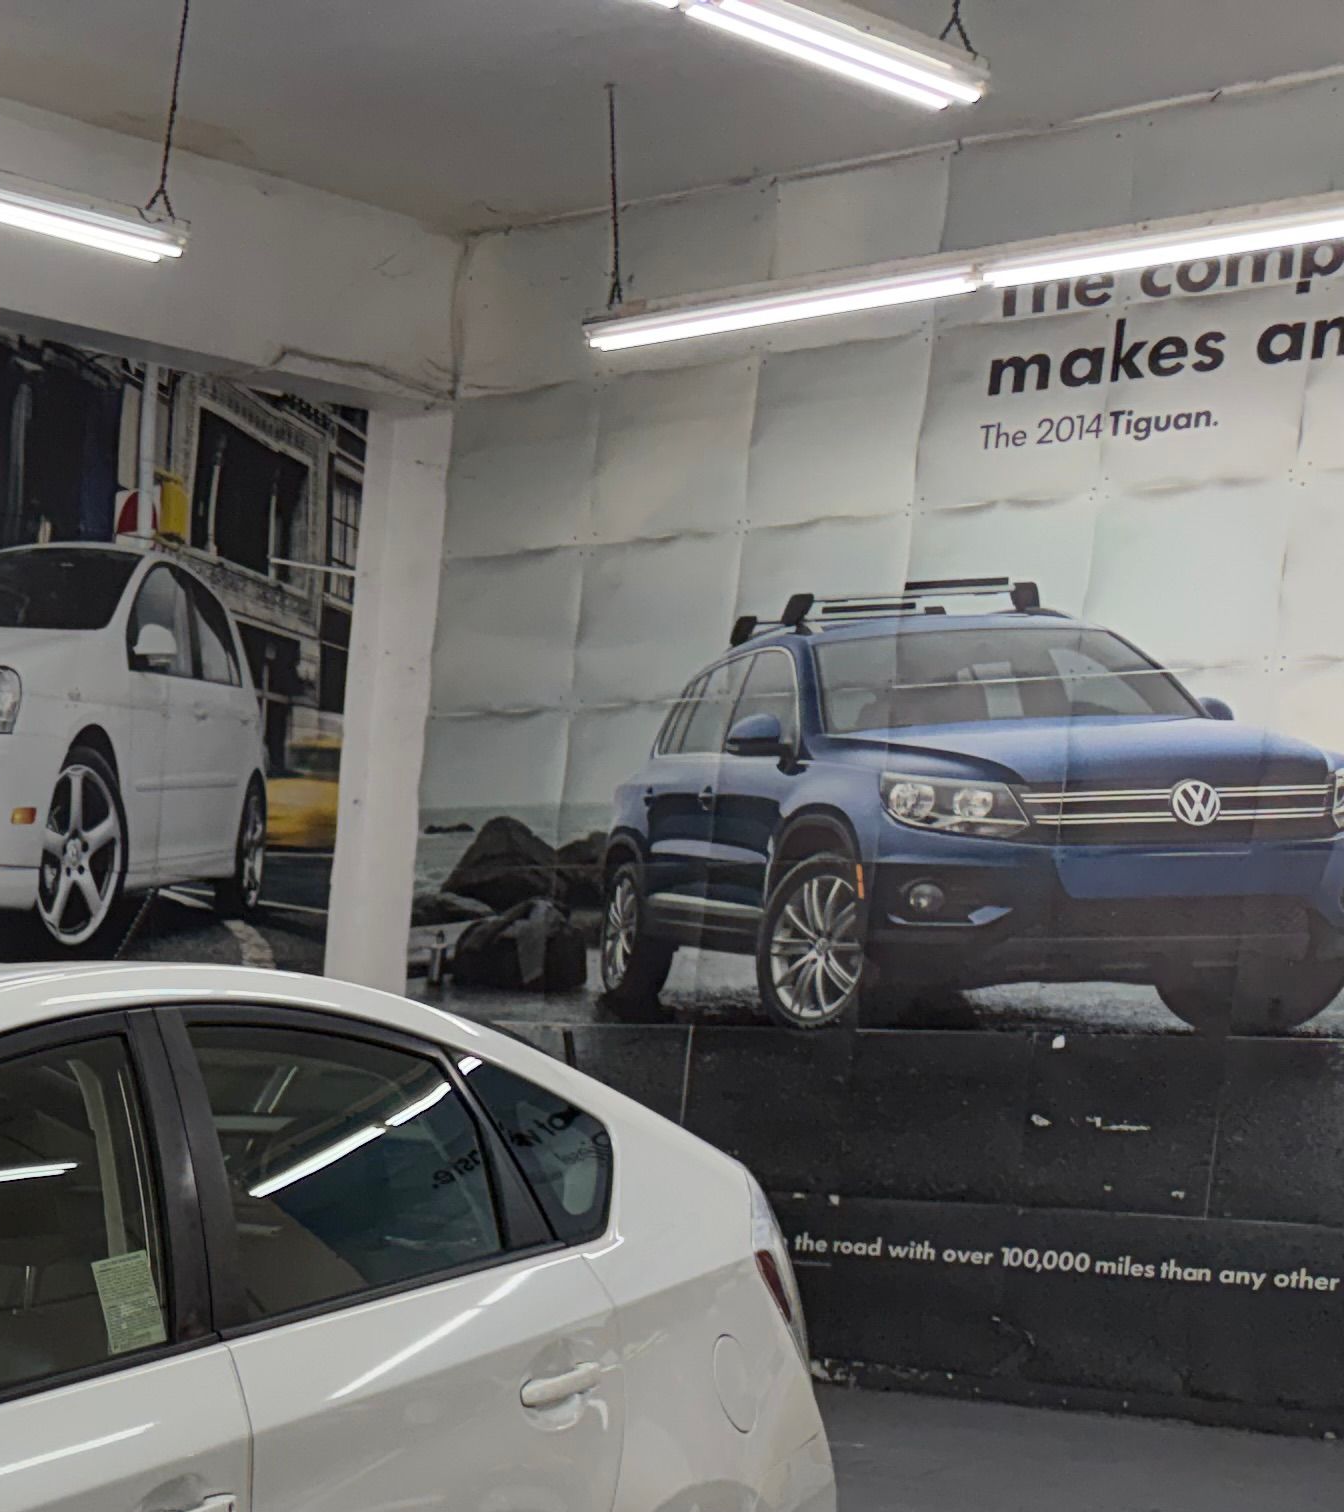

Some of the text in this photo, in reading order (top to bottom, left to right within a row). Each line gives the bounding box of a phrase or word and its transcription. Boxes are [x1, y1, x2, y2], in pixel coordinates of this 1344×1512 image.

[987, 317, 1226, 397] makes
[980, 408, 1220, 451] The 2014 Tiguan.
[794, 1231, 828, 1253] the
[832, 1236, 883, 1257] road
[887, 1240, 936, 1262] with
[942, 1248, 995, 1266] over
[1000, 1246, 1091, 1274] 100,000
[1094, 1255, 1156, 1279] miles
[1160, 1258, 1212, 1283] than
[1218, 1268, 1268, 1291] any
[1273, 1267, 1341, 1292] other
